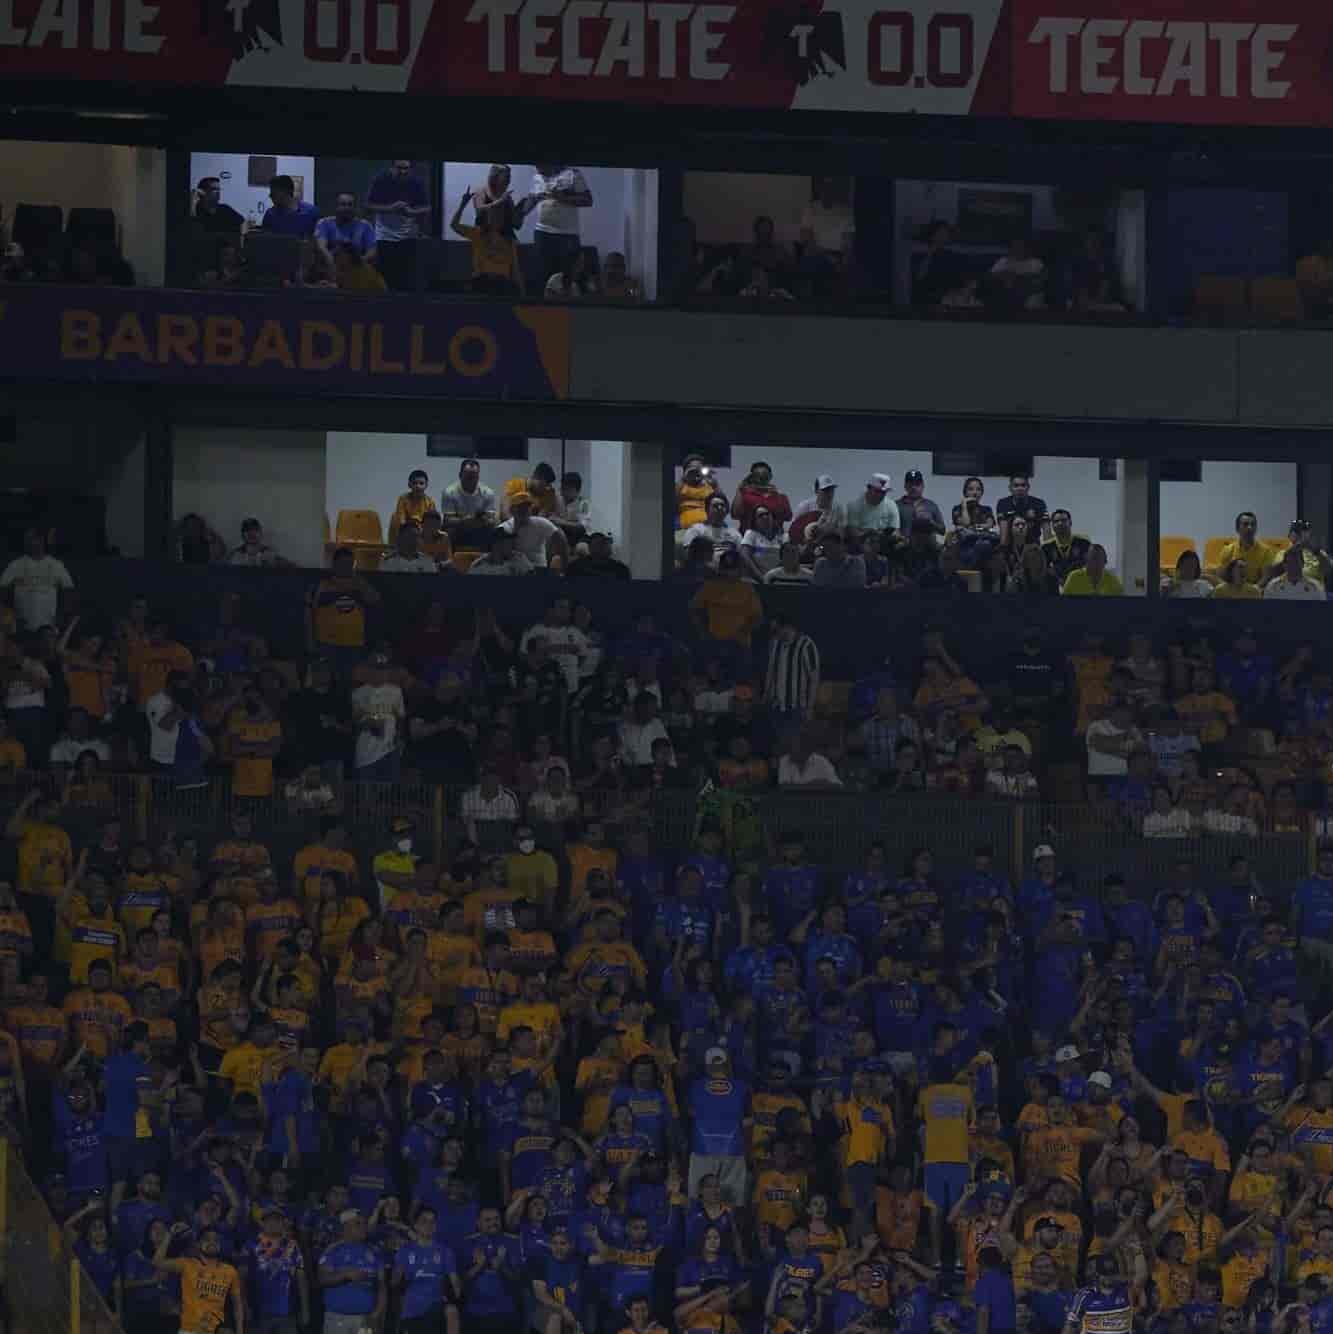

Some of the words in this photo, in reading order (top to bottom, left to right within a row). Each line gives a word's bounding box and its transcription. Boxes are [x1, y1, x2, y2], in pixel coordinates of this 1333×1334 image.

[0, 0, 168, 55] CATE
[466, 3, 734, 81] TECATE
[867, 14, 974, 88] 0.0
[1028, 18, 1299, 98] TECATE
[60, 308, 498, 378] BARBADILLO
